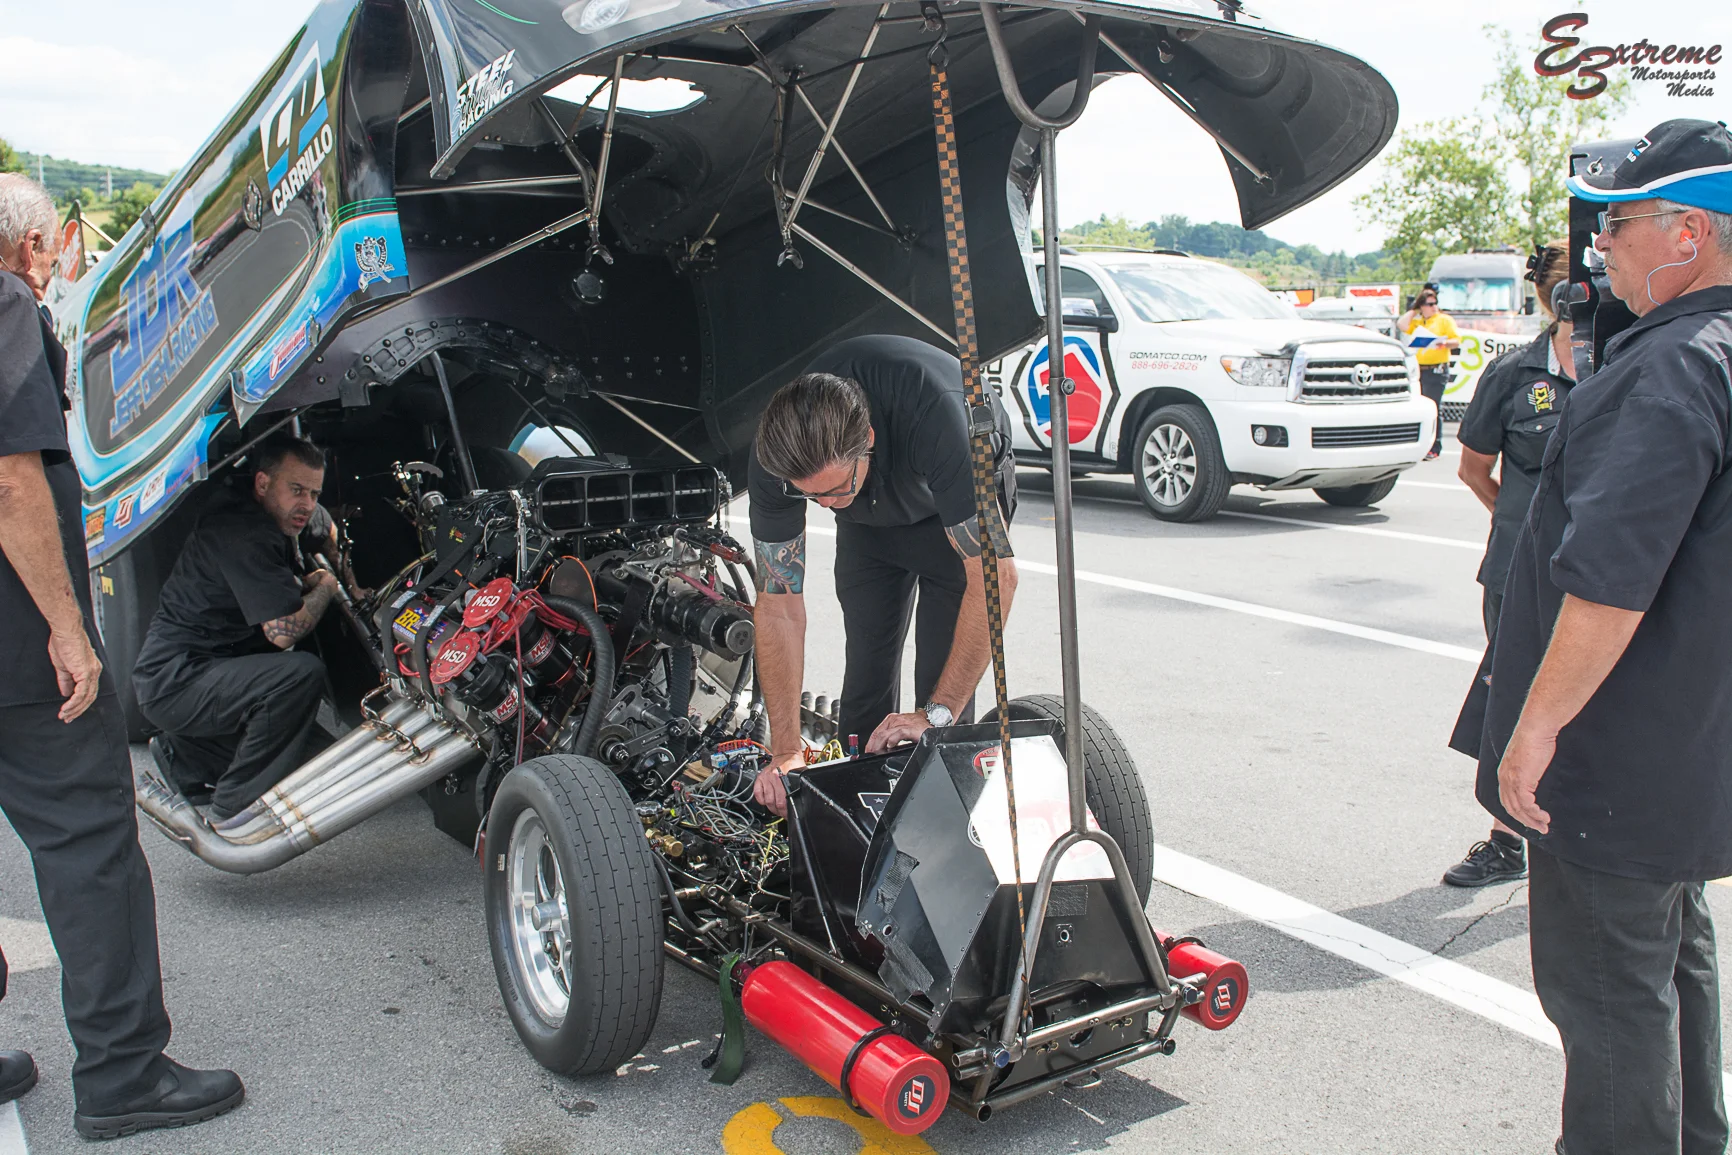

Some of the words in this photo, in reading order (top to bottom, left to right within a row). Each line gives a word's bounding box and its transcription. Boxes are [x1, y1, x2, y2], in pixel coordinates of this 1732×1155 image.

[456, 48, 516, 110] STEEL
[459, 79, 514, 136] RACING
[271, 123, 333, 217] CARRILLO
[110, 376, 142, 440] JEFF
[167, 284, 220, 370] RACING
[1129, 351, 1208, 362] GOMATCO.COM
[1131, 360, 1199, 372] 888-696-2826
[471, 595, 502, 607] MSD
[440, 649, 467, 664] MSD
[531, 632, 551, 659] MSD
[496, 688, 518, 717] MSD
